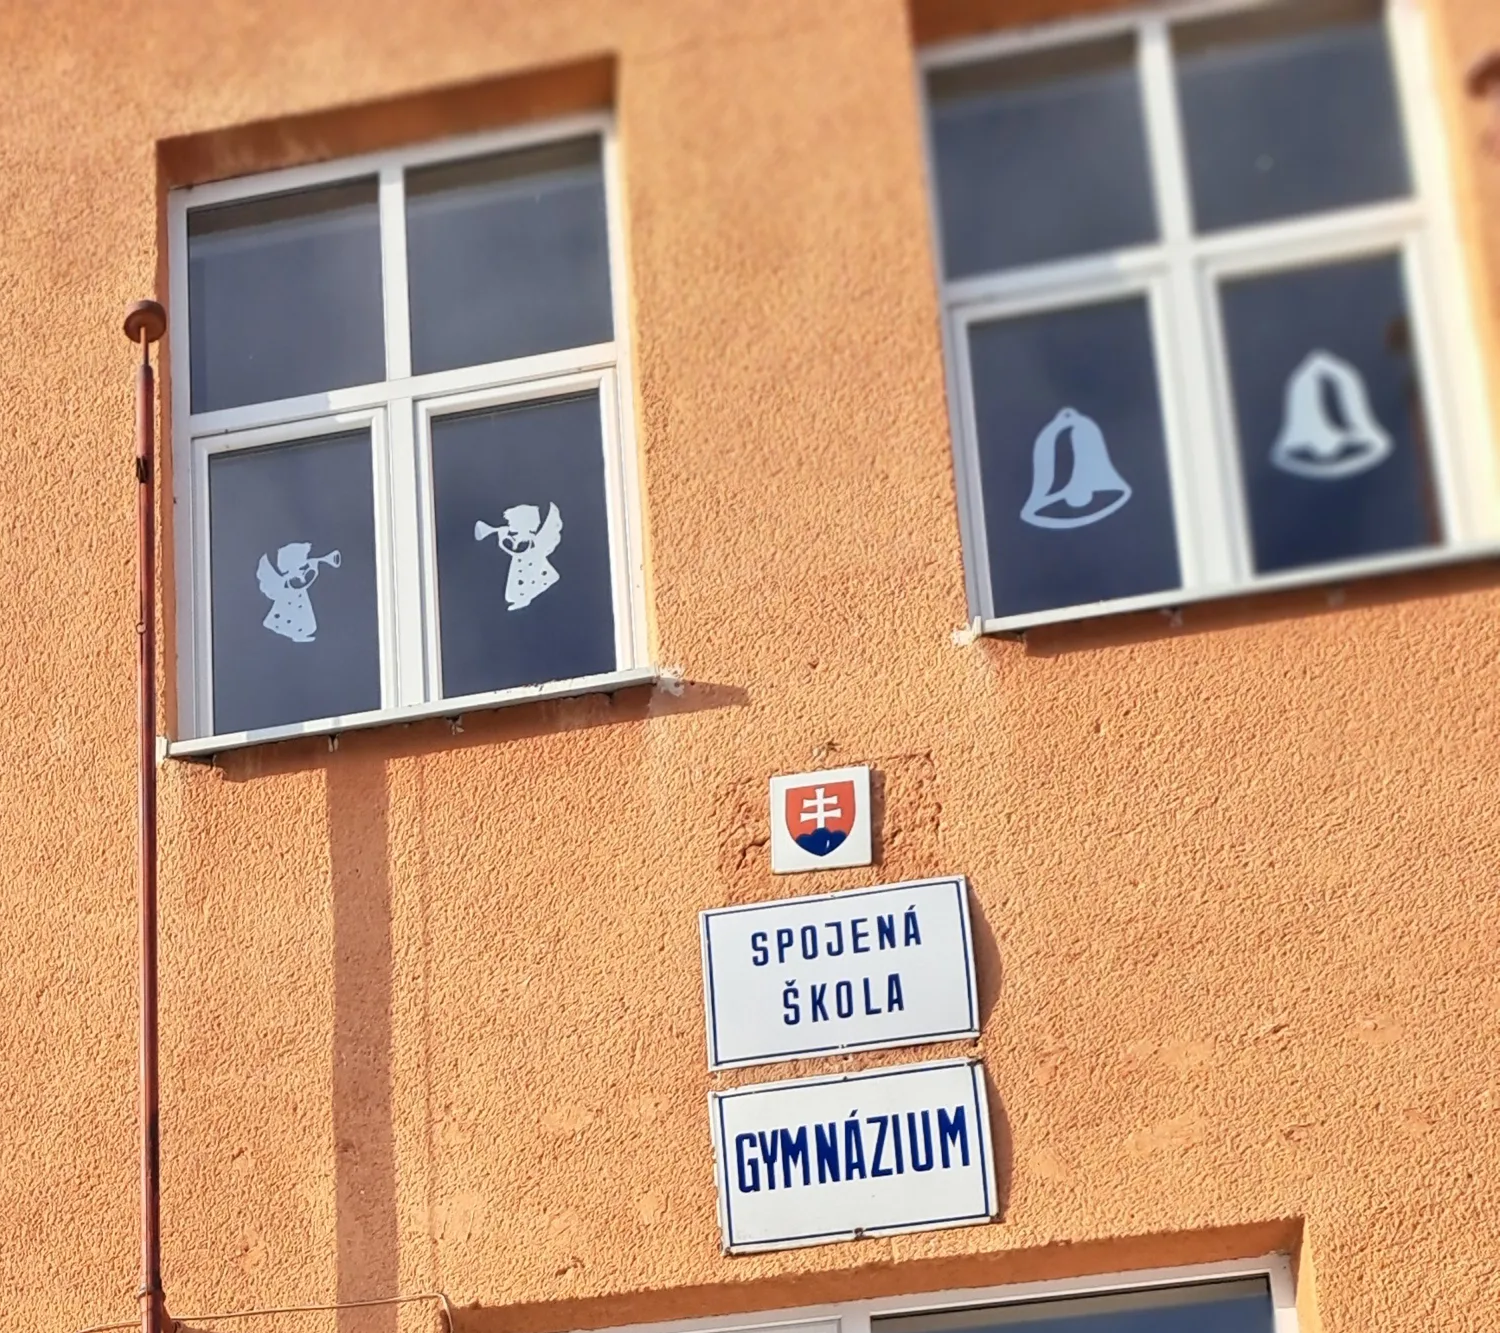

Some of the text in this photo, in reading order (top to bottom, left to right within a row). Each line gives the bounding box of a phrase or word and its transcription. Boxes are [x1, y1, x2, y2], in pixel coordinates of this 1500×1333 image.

[750, 904, 922, 967] SPOJENÁ
[782, 972, 905, 1026] ŠKOLA
[734, 1105, 970, 1194] GYMNÁZIUM
